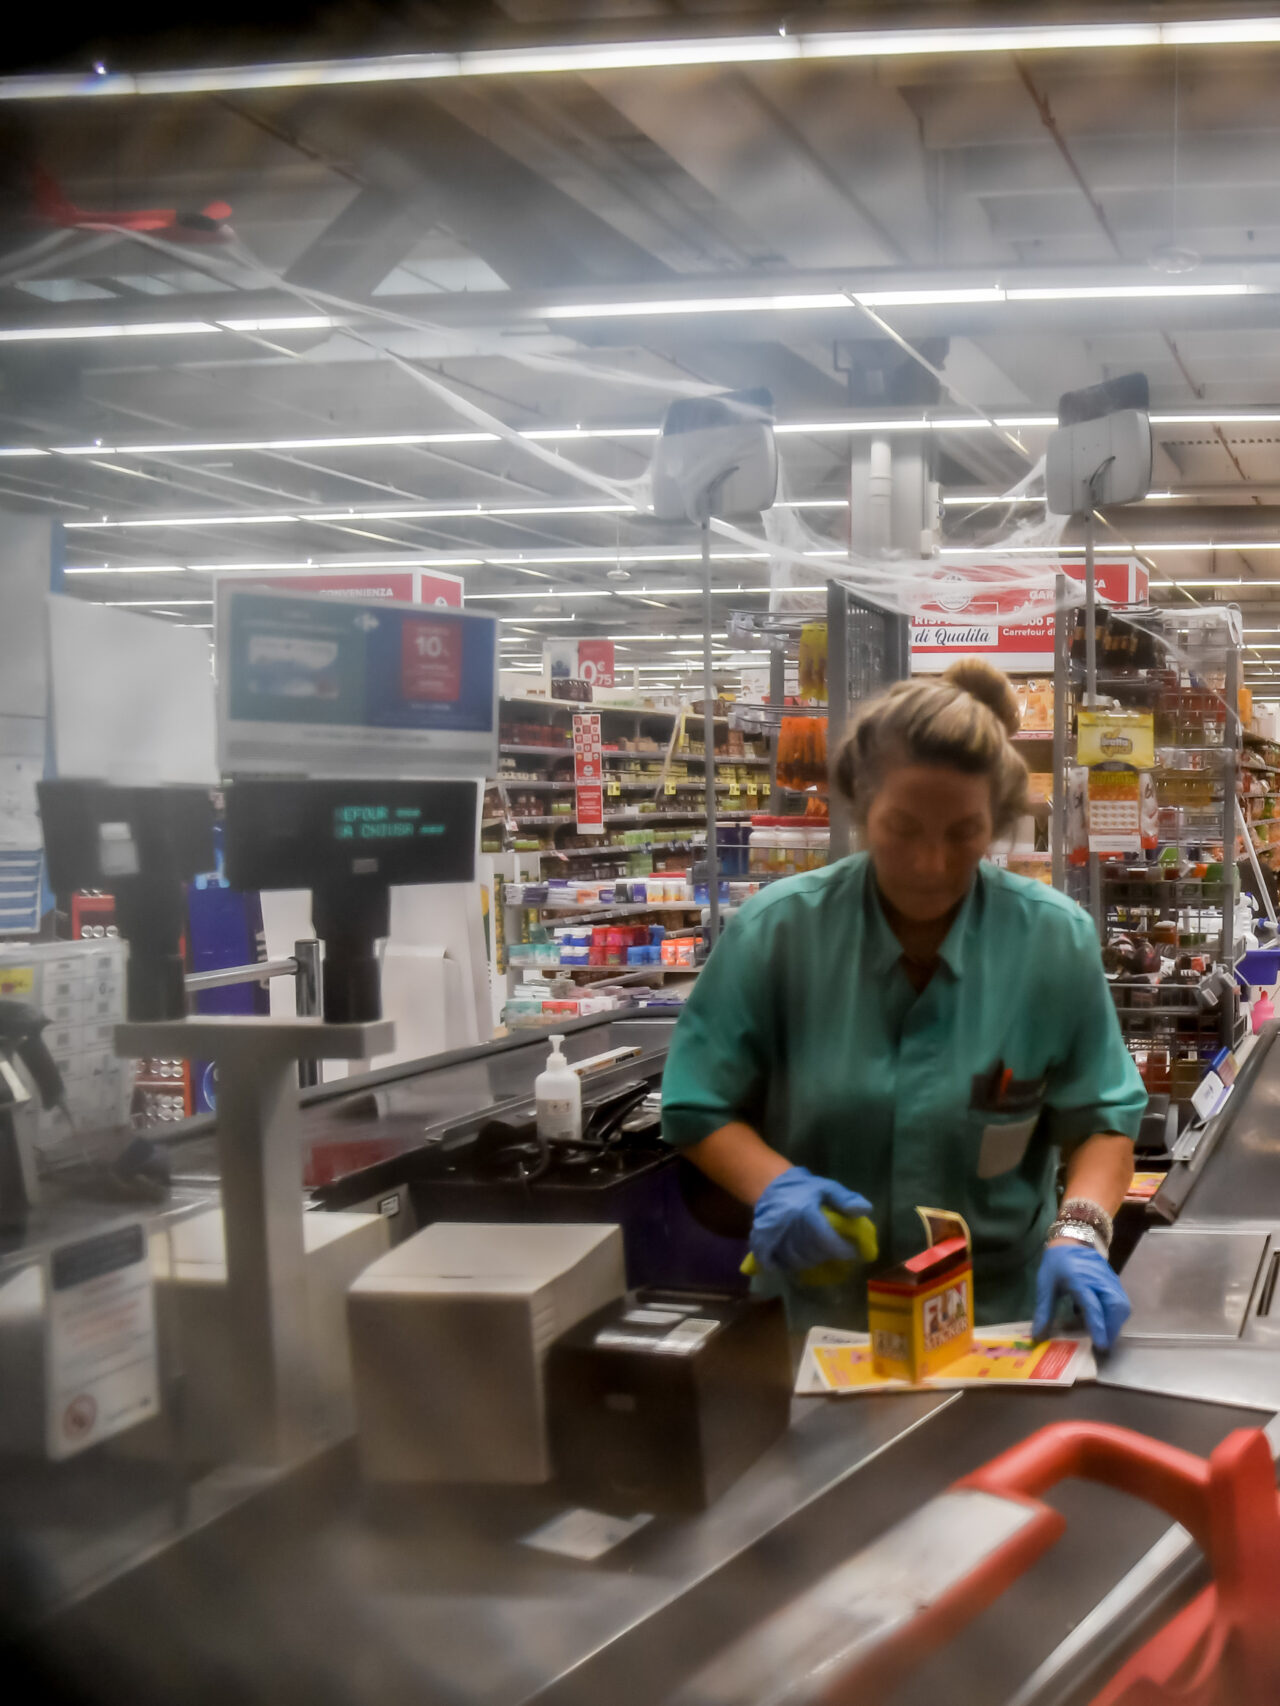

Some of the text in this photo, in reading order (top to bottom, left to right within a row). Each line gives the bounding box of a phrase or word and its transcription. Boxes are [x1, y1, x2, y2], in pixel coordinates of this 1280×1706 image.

[914, 628, 930, 644] di
[1002, 628, 1045, 637] Carrefour
[415, 636, 443, 657] 10
[924, 1281, 968, 1335] FUN
